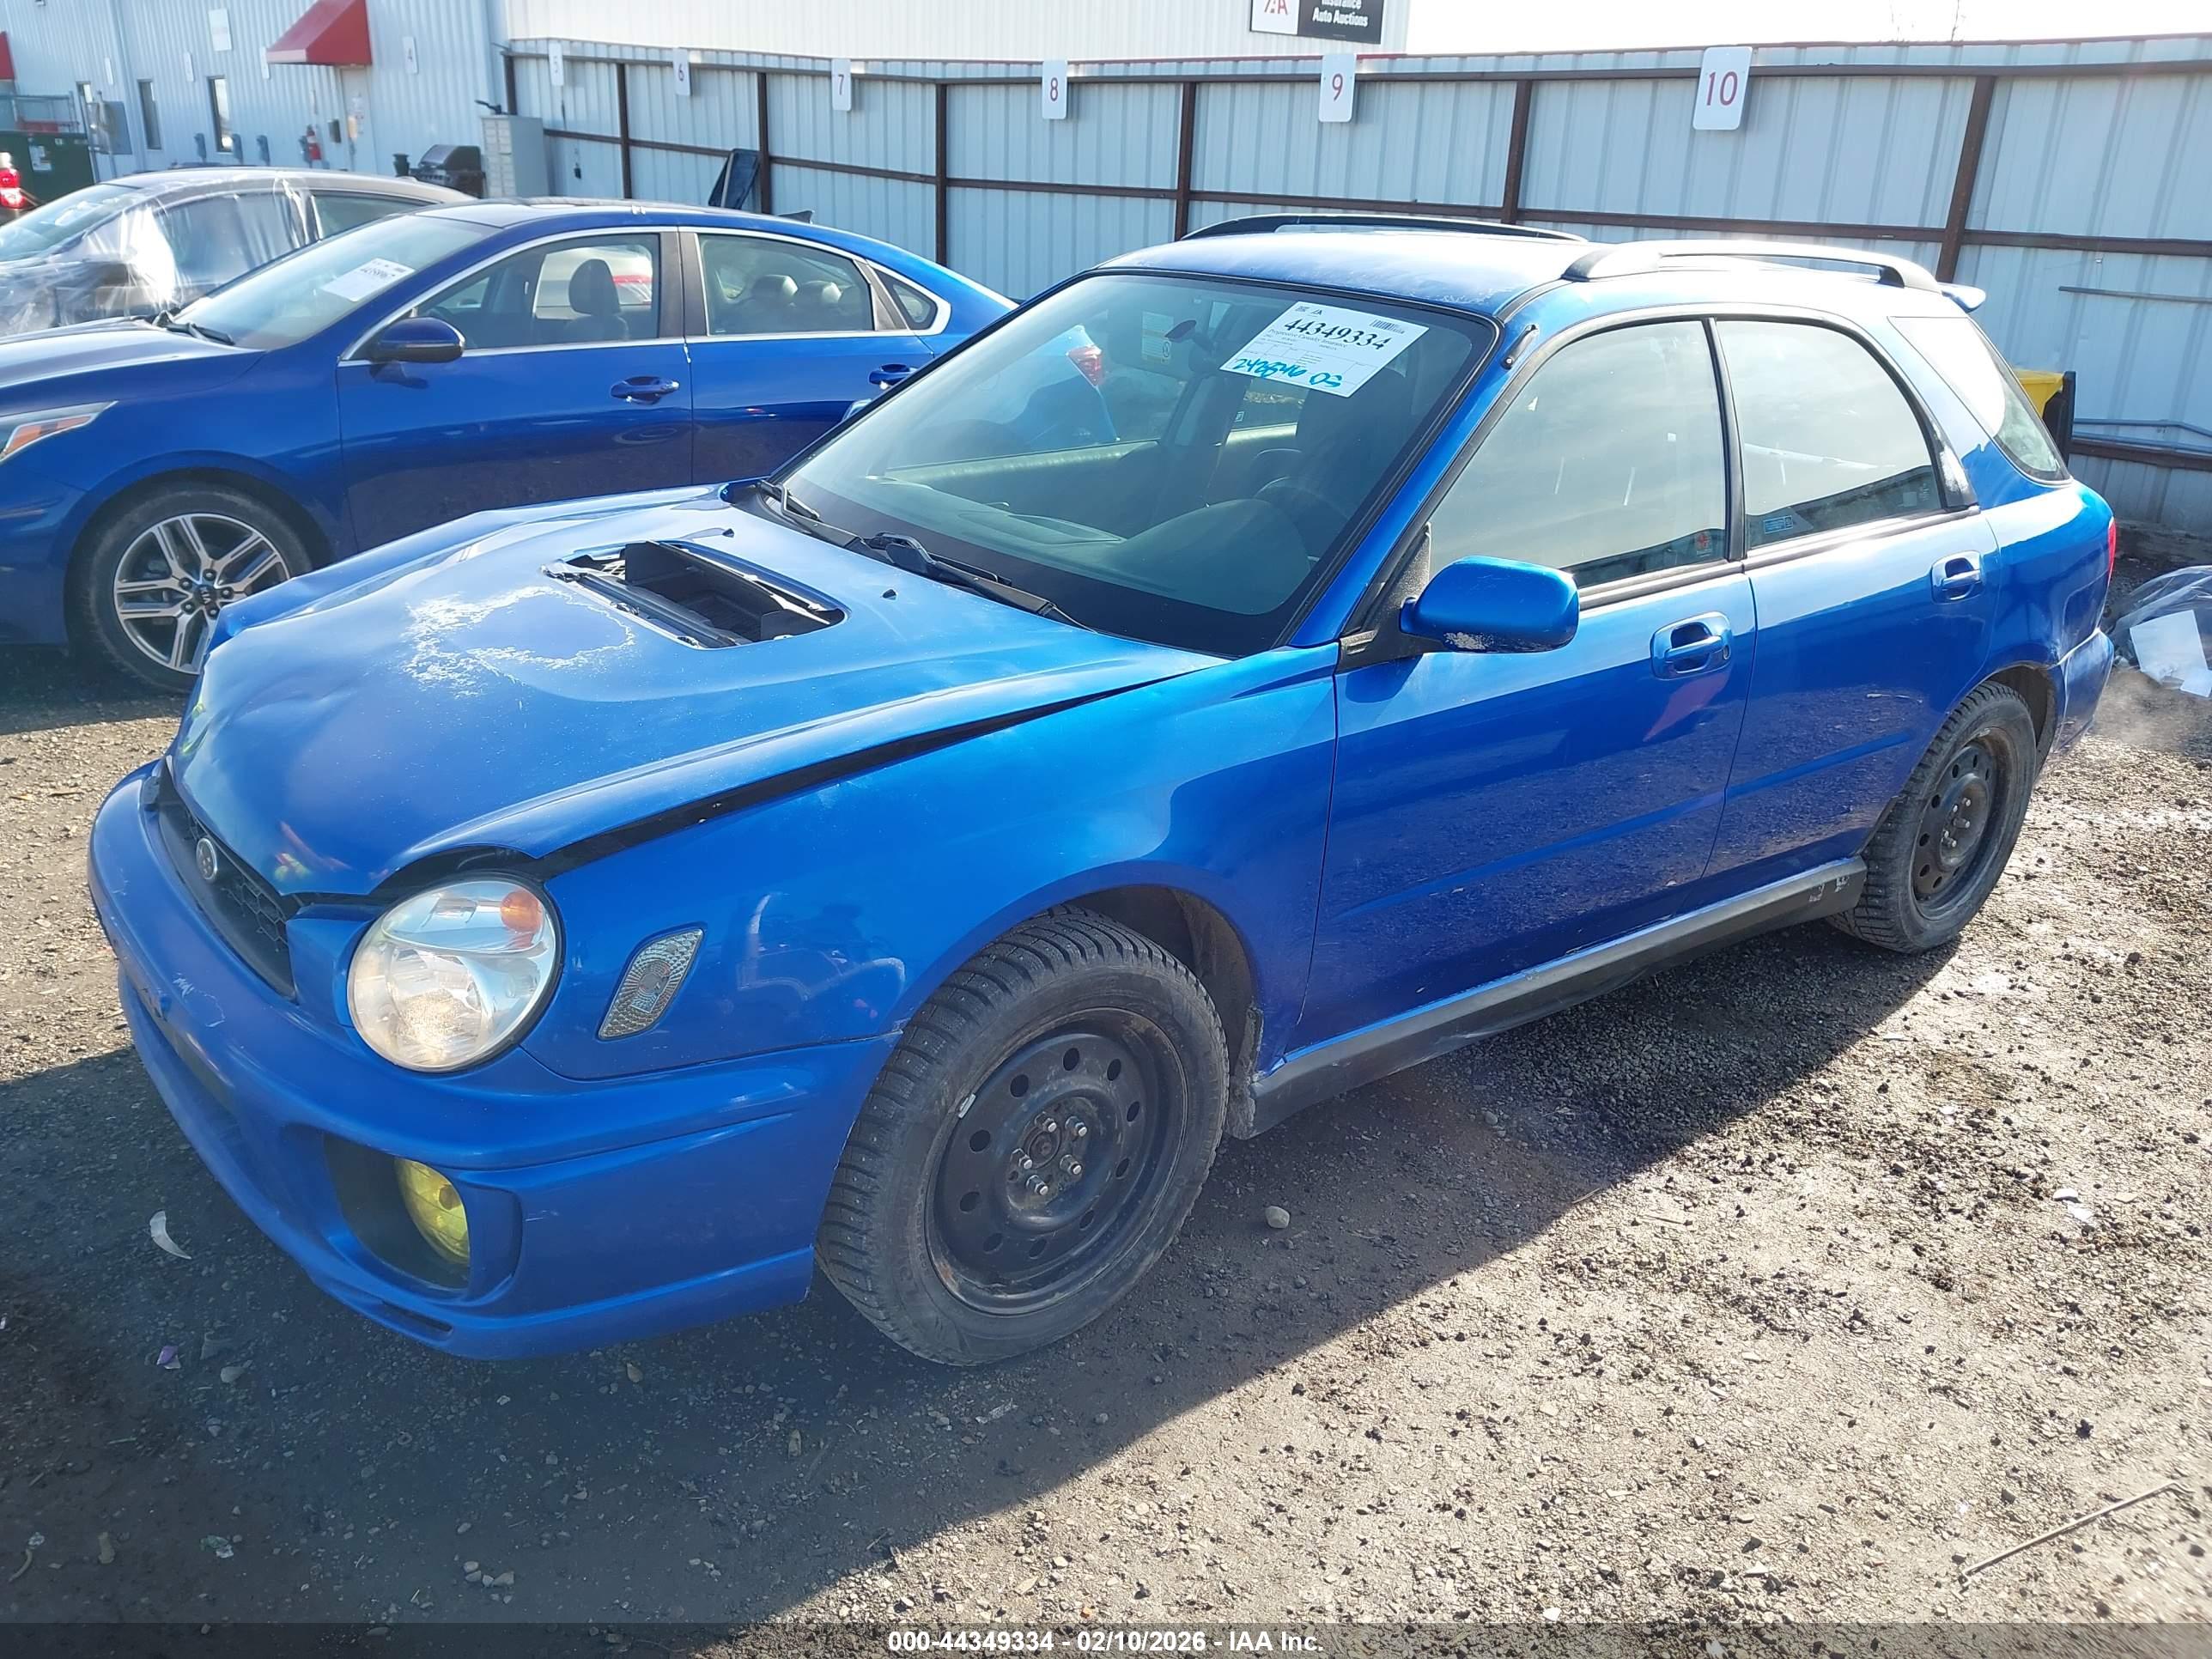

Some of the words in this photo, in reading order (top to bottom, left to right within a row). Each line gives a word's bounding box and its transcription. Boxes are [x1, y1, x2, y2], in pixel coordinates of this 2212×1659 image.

[1312, 7, 1333, 23] Auto
[1333, 9, 1368, 27] Auctions
[678, 64, 685, 82] 6
[837, 74, 845, 96] 7
[1049, 76, 1059, 102] 8
[1332, 73, 1344, 102] 9
[1706, 70, 1739, 106] 10
[1285, 319, 1393, 350] 44349334
